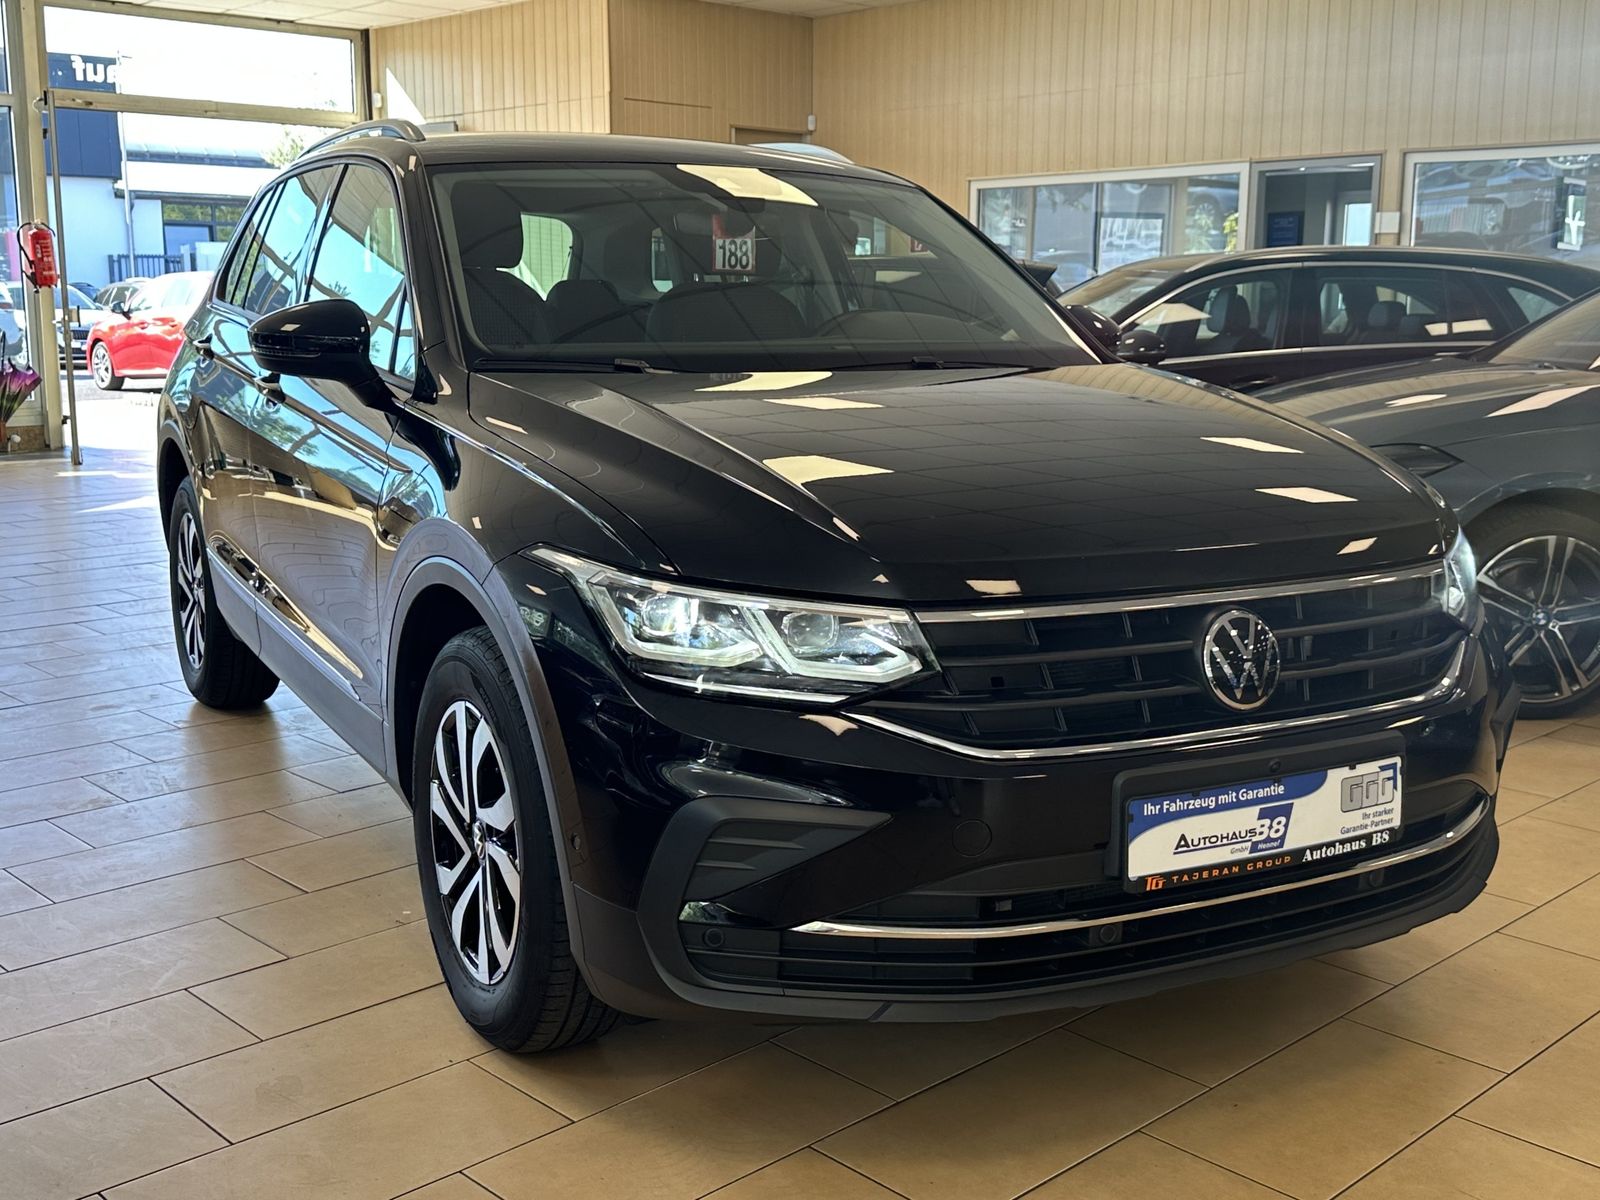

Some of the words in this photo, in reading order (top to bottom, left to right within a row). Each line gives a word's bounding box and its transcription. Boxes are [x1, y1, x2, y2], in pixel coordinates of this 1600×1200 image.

[719, 239, 750, 270] 188
[1143, 803, 1160, 816] Ihr
[1163, 796, 1216, 813] Fahrzeug
[1218, 790, 1237, 808] mit
[1239, 783, 1285, 801] Garantie
[1362, 811, 1371, 820] Ihr
[1372, 807, 1394, 819] starker
[1340, 816, 1394, 835] Garantie-Partner
[1230, 845, 1249, 855] GmbH
[1302, 838, 1367, 862] Autohaus
[1371, 830, 1390, 846] B8
[1171, 865, 1240, 884] TAJERAN
[1246, 855, 1292, 871] GROUP
